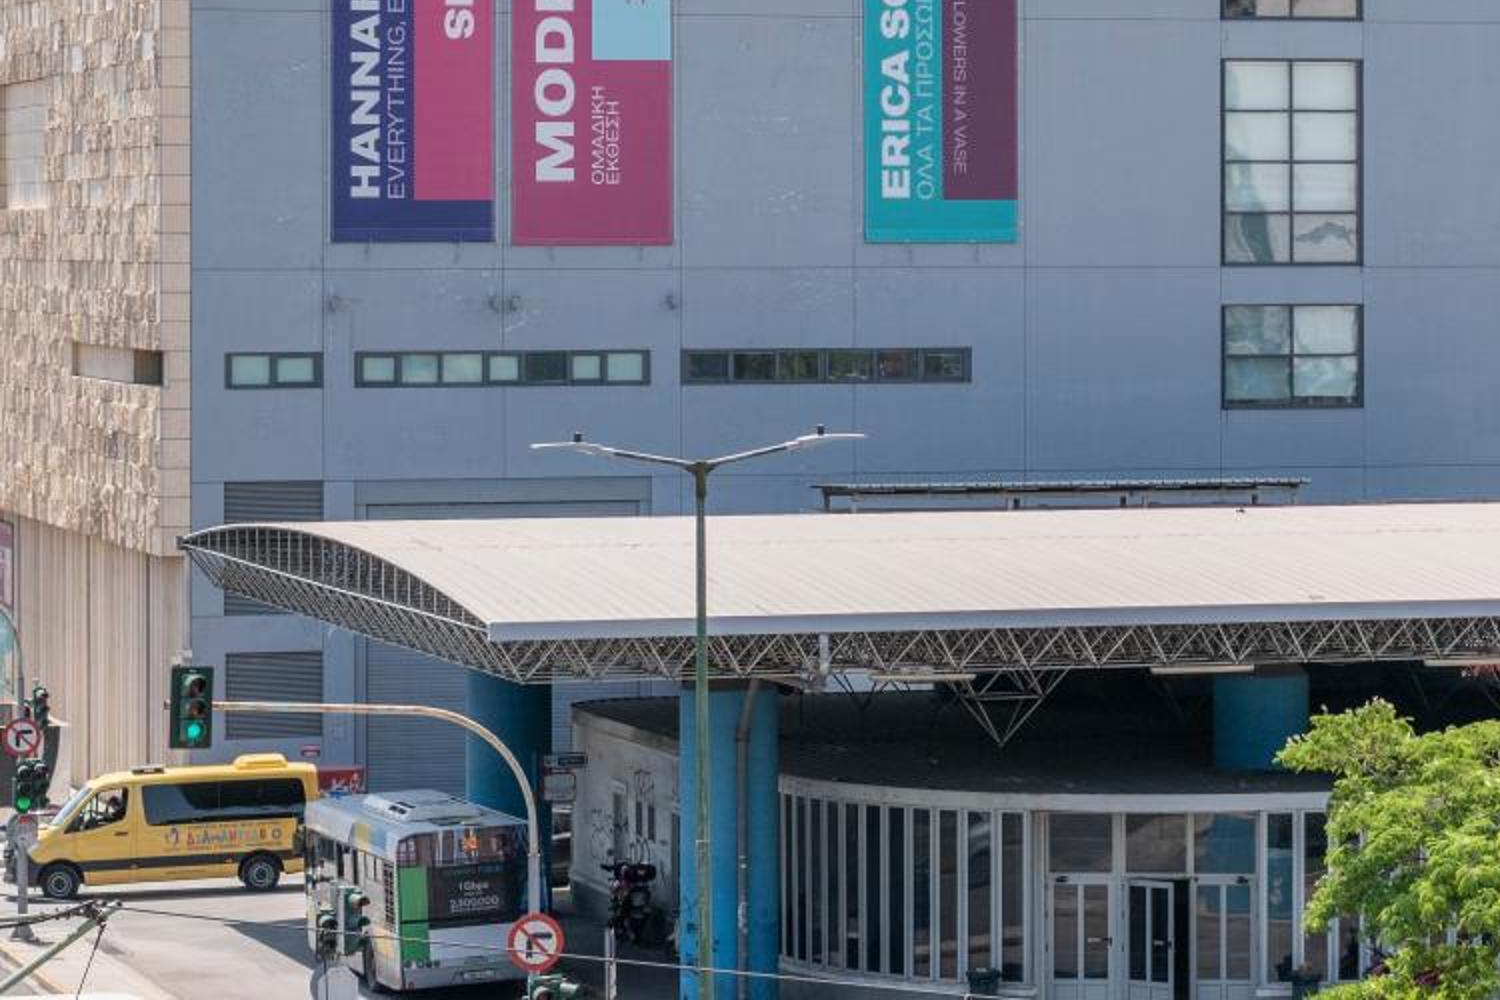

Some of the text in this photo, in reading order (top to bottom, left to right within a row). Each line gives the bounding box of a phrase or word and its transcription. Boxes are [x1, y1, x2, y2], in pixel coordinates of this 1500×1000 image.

[386, 20, 407, 200] EVERYTHING,
[591, 85, 605, 185] ΟΜΑΔΙΚΗ
[606, 100, 620, 185] ΕΚΘΕΣΗ
[880, 49, 911, 200] ERICA
[916, 103, 935, 138] ΤΑ
[916, 146, 935, 200] ΟΛΑ
